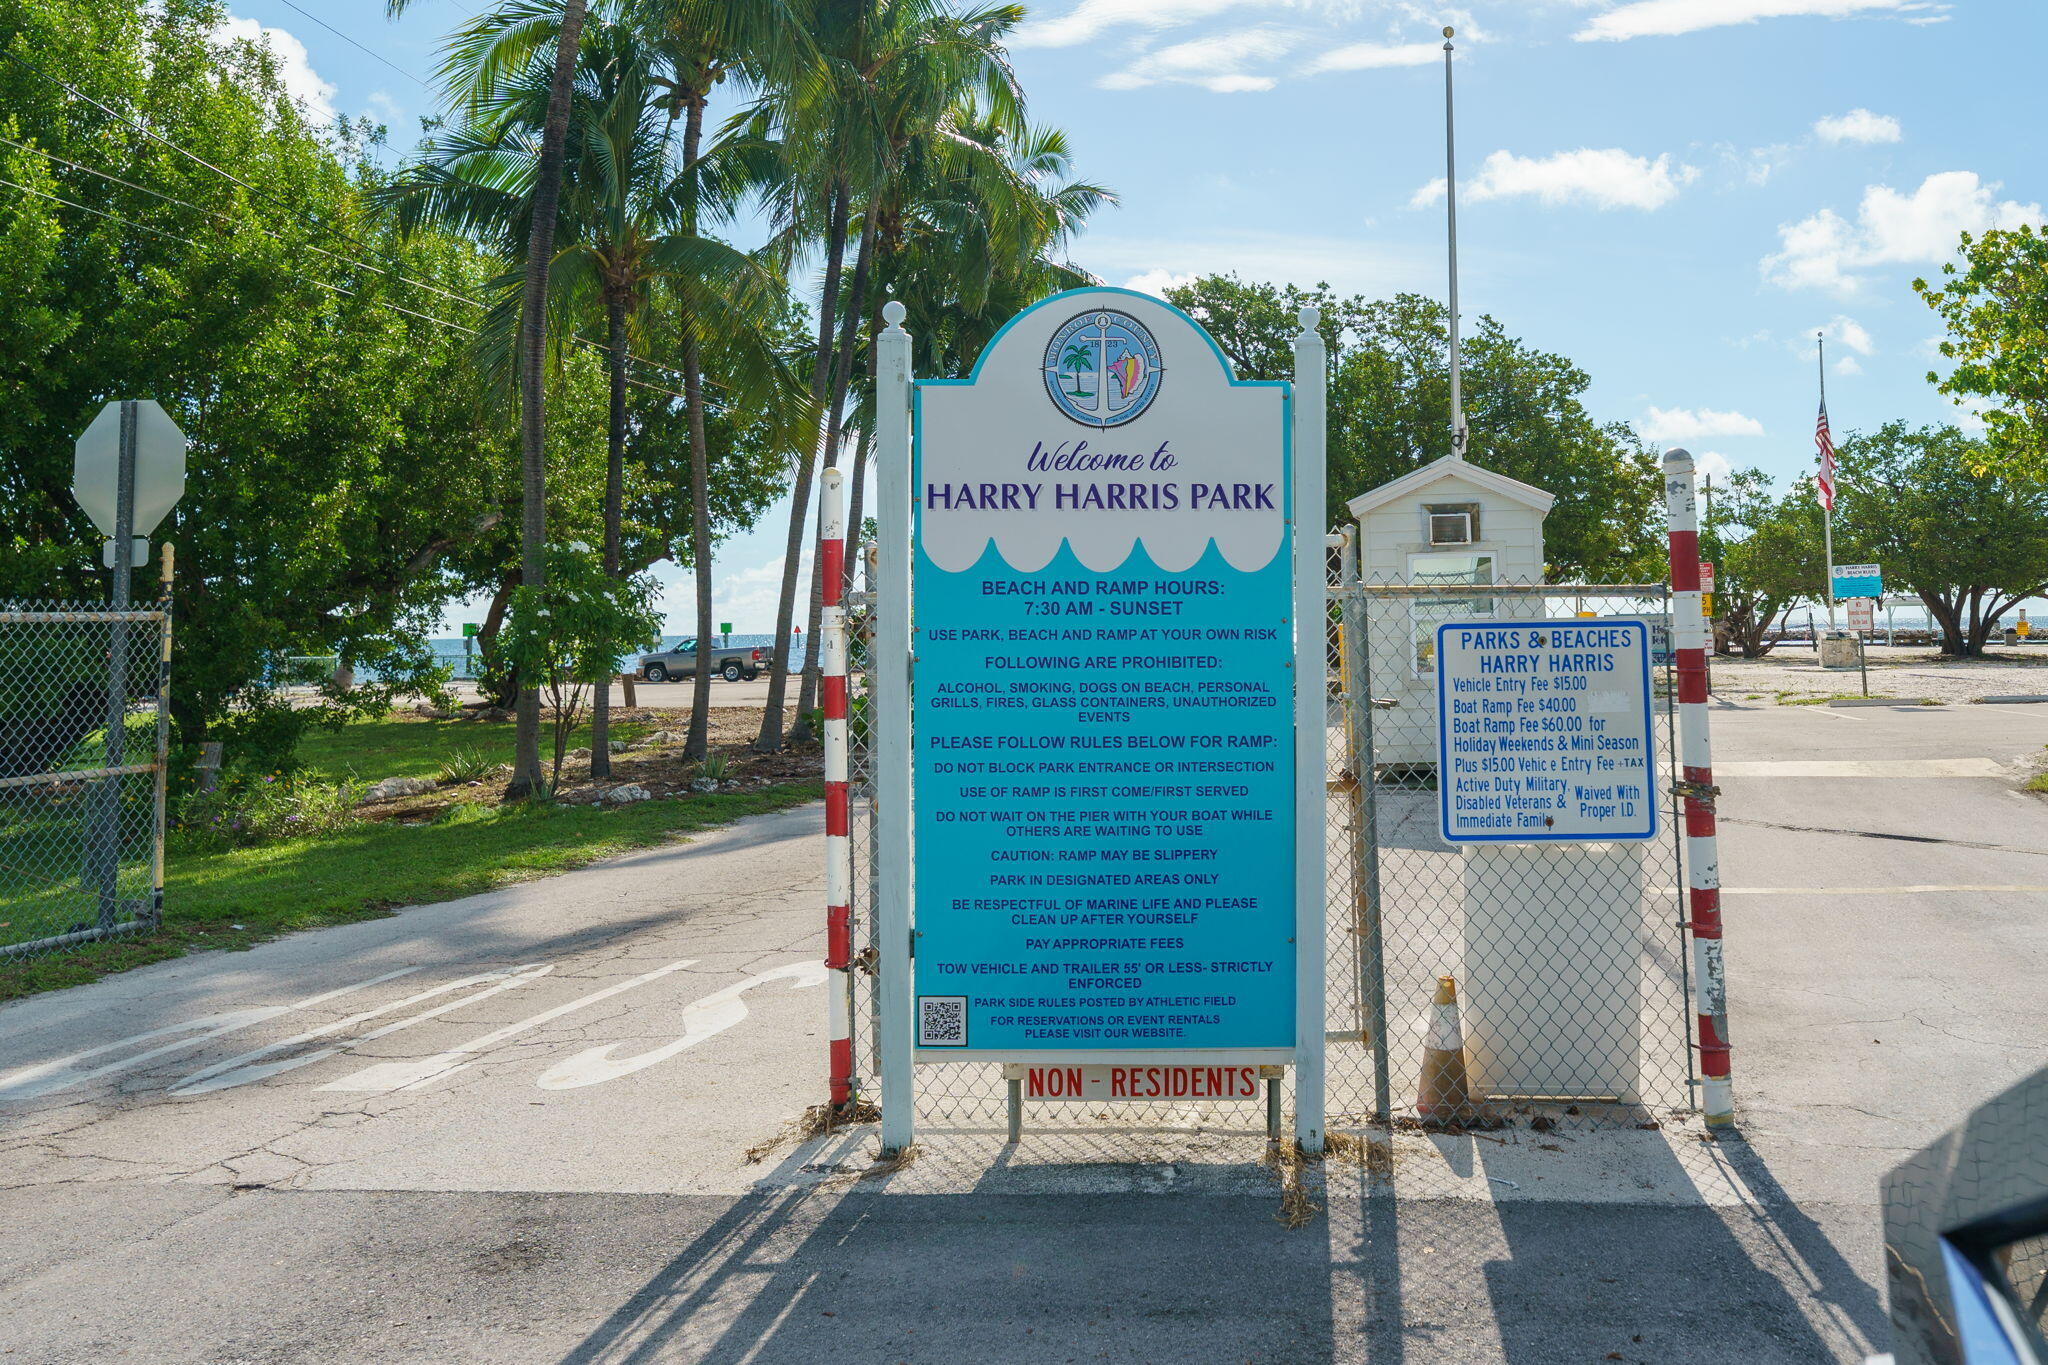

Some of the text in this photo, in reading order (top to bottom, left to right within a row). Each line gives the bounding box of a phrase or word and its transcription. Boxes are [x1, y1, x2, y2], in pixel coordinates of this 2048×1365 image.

[1049, 316, 1158, 363] MONROE COUNTY
[1027, 441, 1178, 472] Welcome to
[927, 483, 1275, 510] HARRY HARRIS PARK
[982, 580, 1225, 596] BEACH AND RAMP HOURS:
[1024, 601, 1061, 616] 7:30
[1065, 601, 1093, 616] AM
[1109, 600, 1184, 616] SUNSET
[929, 628, 1277, 643] USE PARK, BEACH AND RAMP AT YOUR OWN RISK
[1462, 630, 1631, 649] PARKS & BEACHES
[985, 655, 1223, 669] FOLLOWING ARE PROHIBITED:
[1481, 654, 1614, 673] HARRY HARRIS
[937, 681, 1270, 696] ALCOHOL, SMOKING, DOGS ON BEACH, PERSONAL
[1454, 676, 1587, 695] Vehicle Entry Fee $15.00
[930, 696, 1277, 710] GRILLS, FIRES, GLASS CONTAINERS, UNAUTHORIZED
[1454, 698, 1576, 716] Boat Ramp Fee $40.00
[1078, 711, 1130, 723] EVENTS
[1454, 716, 1606, 734] Boat Ramp Fee $60.00 for
[930, 735, 1279, 749] PLEASE FOLLOW RULES BELOW FOR RAMP:
[1455, 735, 1638, 755] Holiday Weekends & Mini Season
[1456, 758, 1477, 772] Plus
[1482, 758, 1515, 772] $15.00
[1518, 757, 1556, 771] Vehice
[1562, 757, 1591, 774] Entry
[1598, 756, 1614, 770] Fee
[1456, 778, 1489, 791] Active
[1495, 778, 1520, 794] Duty
[1576, 786, 1639, 801] Waived With
[1457, 795, 1566, 810] Disabled Veterans &
[1580, 803, 1636, 821] Proper I.D.
[1457, 814, 1511, 828] Immediate
[990, 848, 1218, 862] CAUTION: RAMP MAY BE SLIPPERY
[990, 873, 1219, 886] PARK IN DESIGNATED AREAS ONLY
[952, 897, 1258, 911] BE RESPECTFUL OF MARINE LIFE AND PLEASE
[1011, 912, 1199, 925] CLEAN UP AFTER YOURSELF
[1025, 937, 1185, 950] PAY APPROPRIATE FEES
[936, 961, 1274, 975] TOW VEHICLE AND TRAILER 55' OR LESS- STRICTLY
[1068, 977, 1143, 989] ENFORCED
[974, 995, 1237, 1008] PARK SIDE RULES POSTED BY ATHLETIC FIELD
[990, 1014, 1221, 1026] FOR RESERVATIONS OR EVENT RENTALS
[1024, 1027, 1186, 1039] PLEASE VISIT OUR WEBSITE.
[1028, 1069, 1082, 1096] NON
[1111, 1068, 1255, 1096] RESIDENTS
